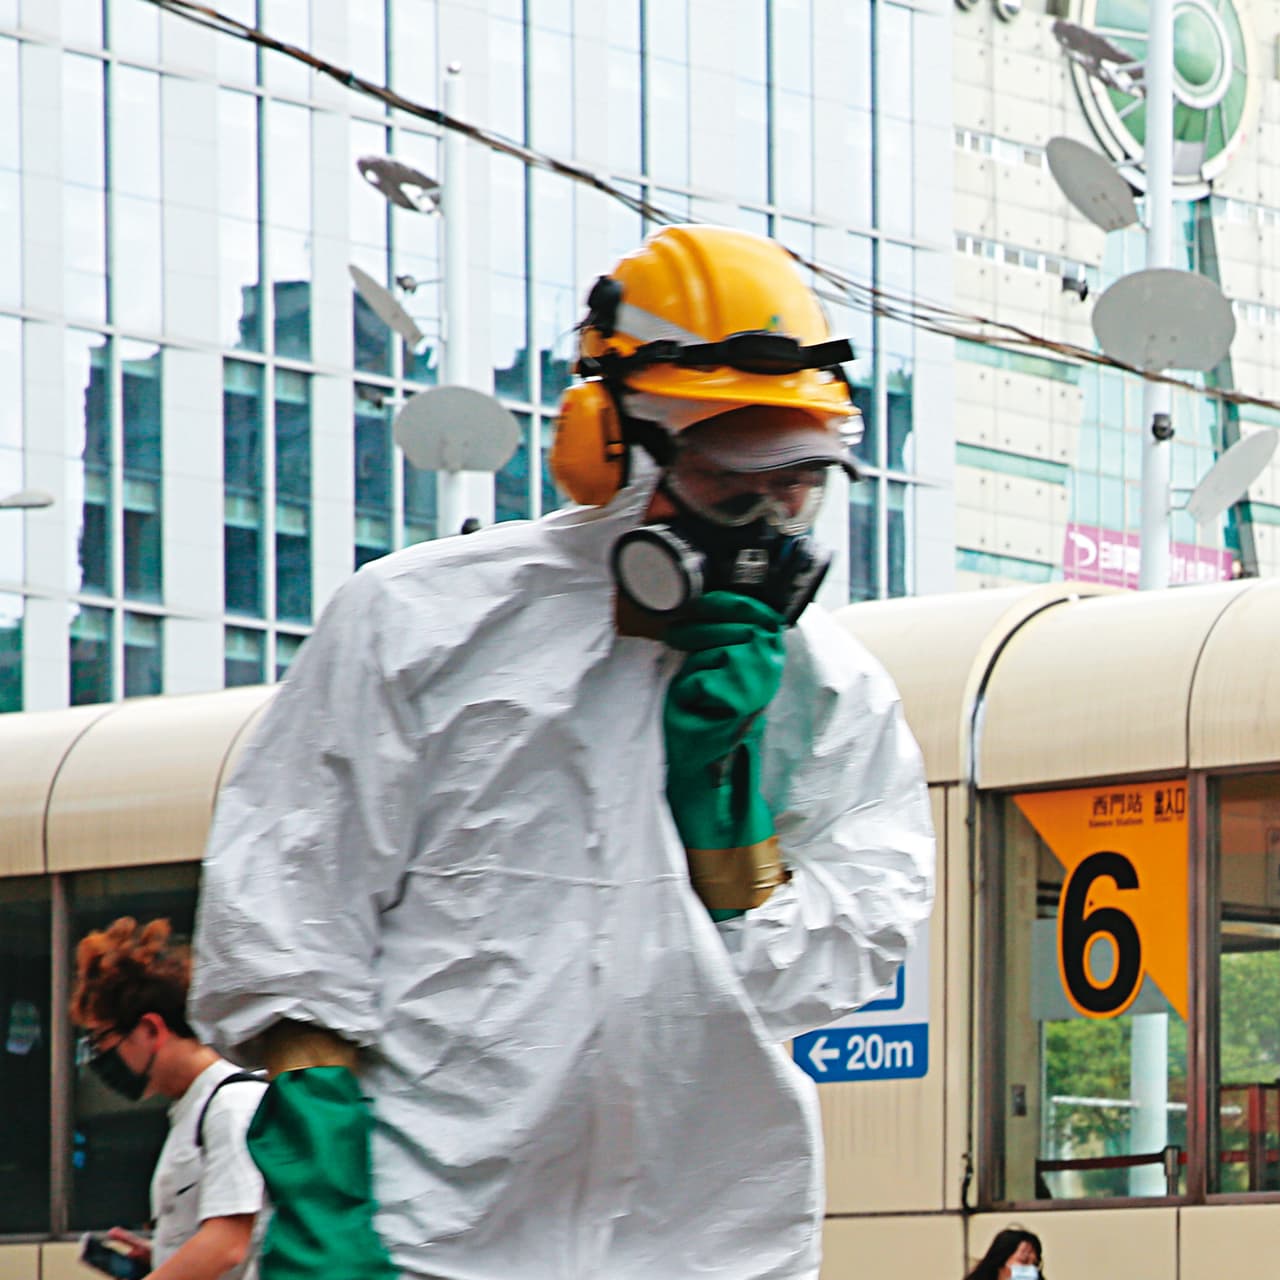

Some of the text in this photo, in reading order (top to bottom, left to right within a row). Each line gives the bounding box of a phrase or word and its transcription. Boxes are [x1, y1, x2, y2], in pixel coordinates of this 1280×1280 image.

[1093, 788, 1185, 817] 西門站 出入口
[1062, 851, 1141, 1014] 6
[846, 1033, 914, 1070] 20m
